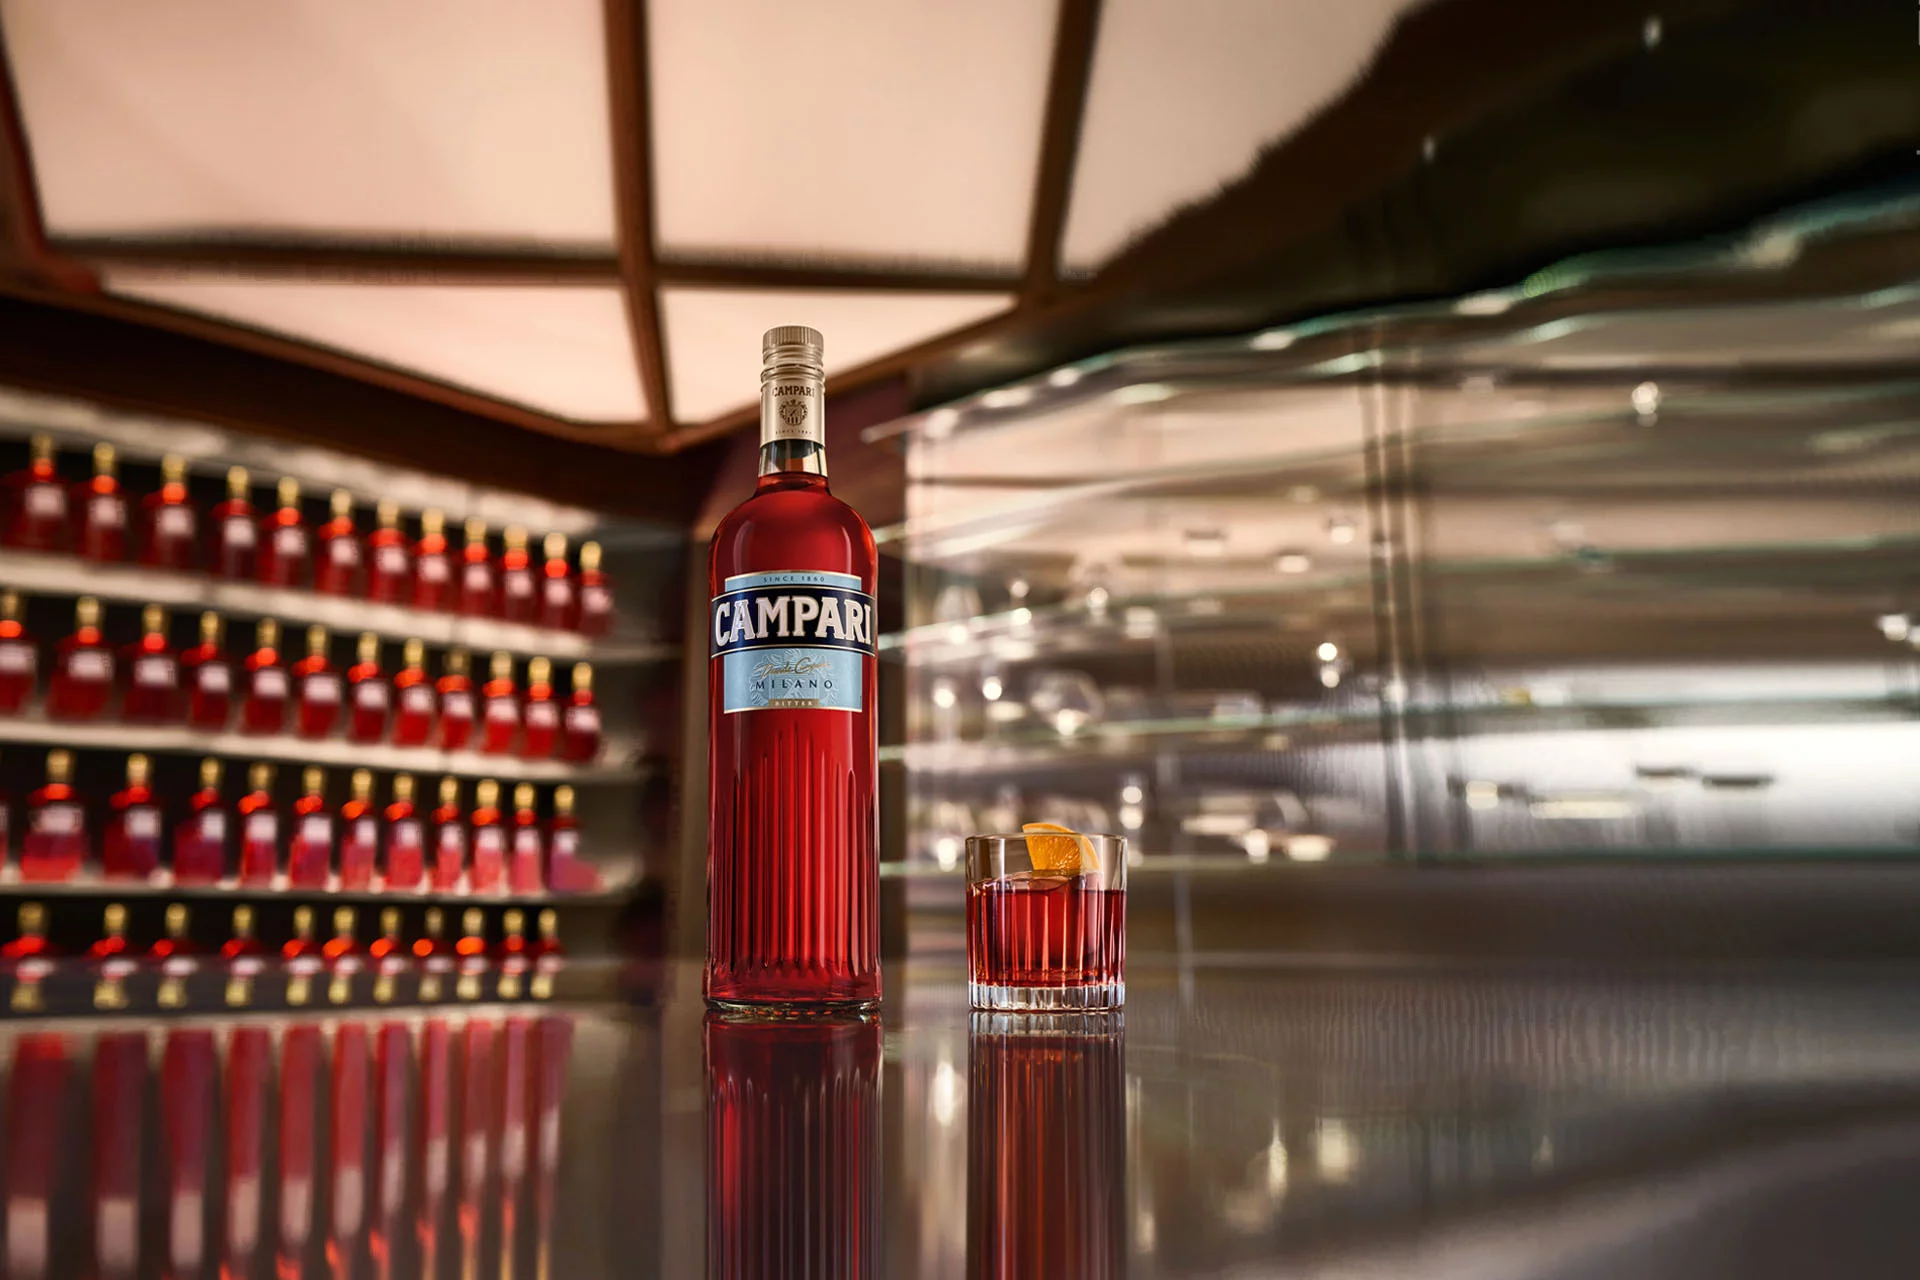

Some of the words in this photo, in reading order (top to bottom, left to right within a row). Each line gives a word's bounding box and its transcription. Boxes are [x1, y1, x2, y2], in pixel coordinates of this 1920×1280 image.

[772, 385, 815, 397] CAMPARI
[763, 575, 794, 583] SINCE
[802, 575, 825, 583] 1860
[715, 595, 872, 647] CAMPARI
[755, 679, 833, 691] MILANO
